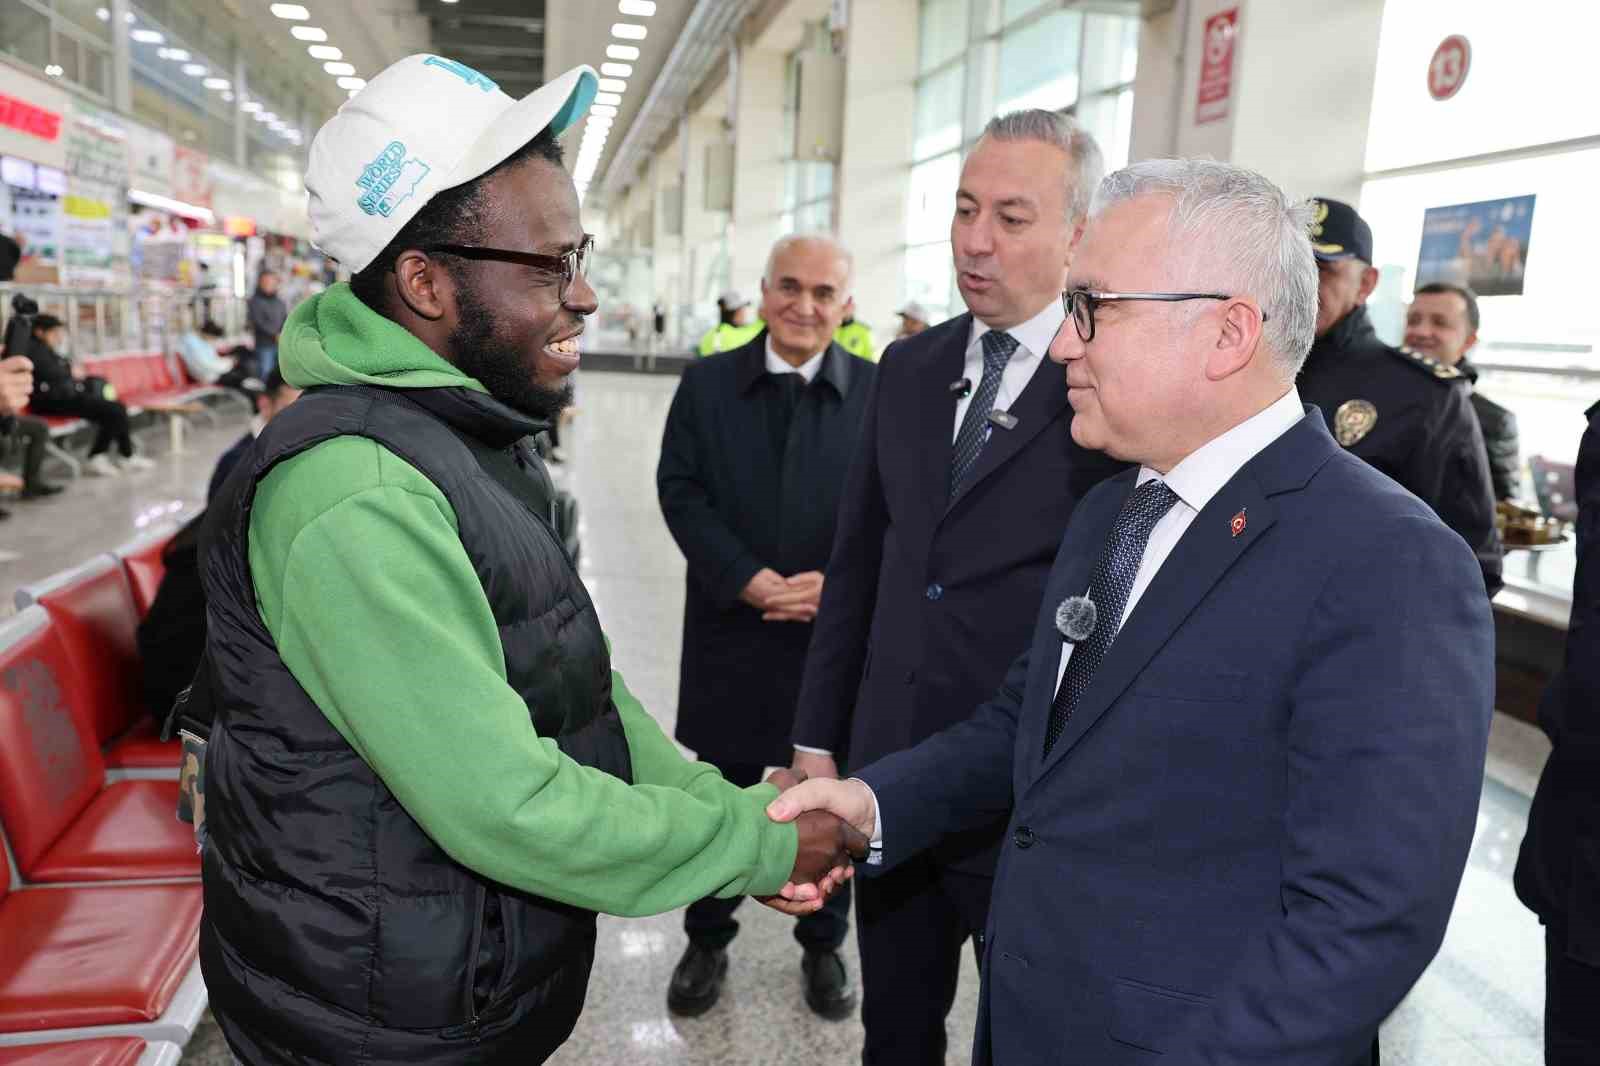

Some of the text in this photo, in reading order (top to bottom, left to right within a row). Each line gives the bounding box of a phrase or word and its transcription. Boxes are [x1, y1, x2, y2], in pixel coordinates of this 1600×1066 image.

[1435, 48, 1460, 88] 13
[357, 141, 405, 191] WORLD
[357, 164, 402, 215] SERIES
